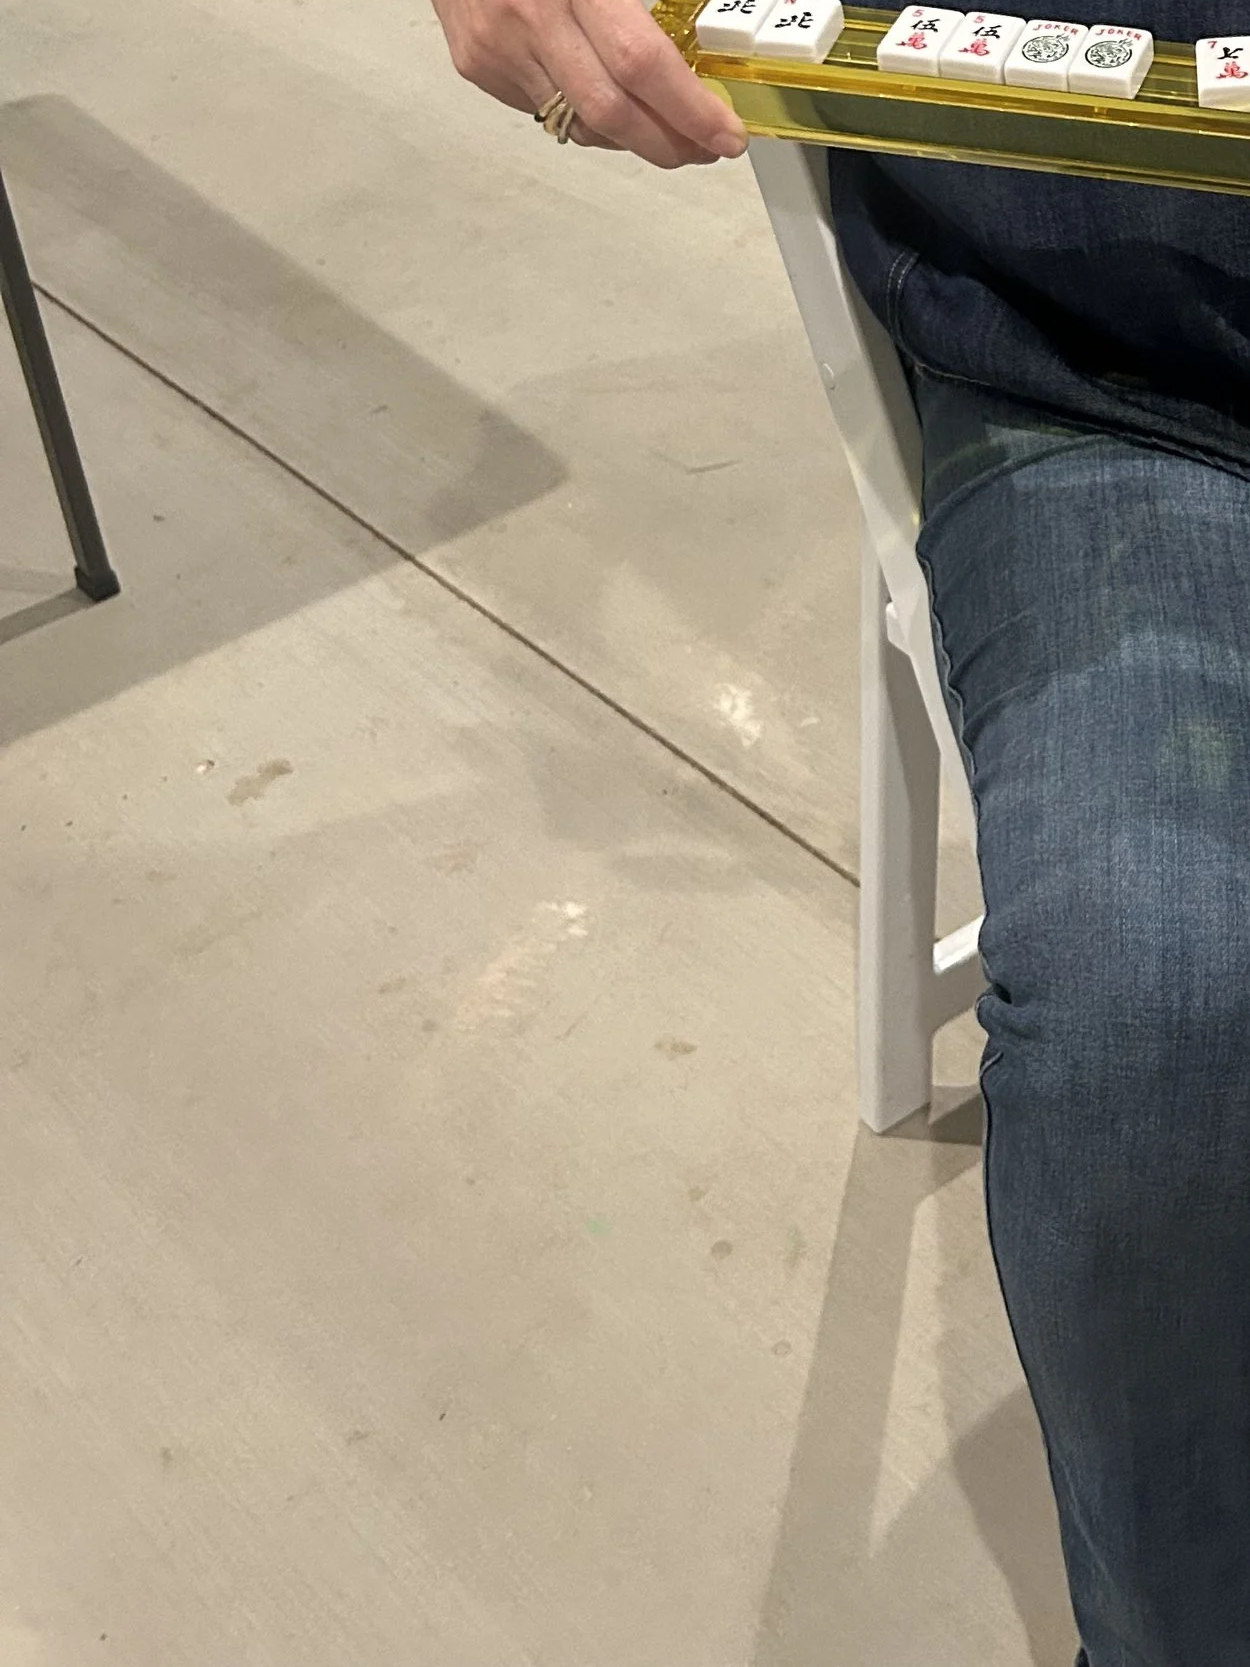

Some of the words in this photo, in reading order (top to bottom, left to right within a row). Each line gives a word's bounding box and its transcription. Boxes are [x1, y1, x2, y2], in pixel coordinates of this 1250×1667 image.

[912, 9, 924, 17] 5
[1033, 24, 1078, 35] JOKER
[1096, 28, 1141, 40] JOKER
